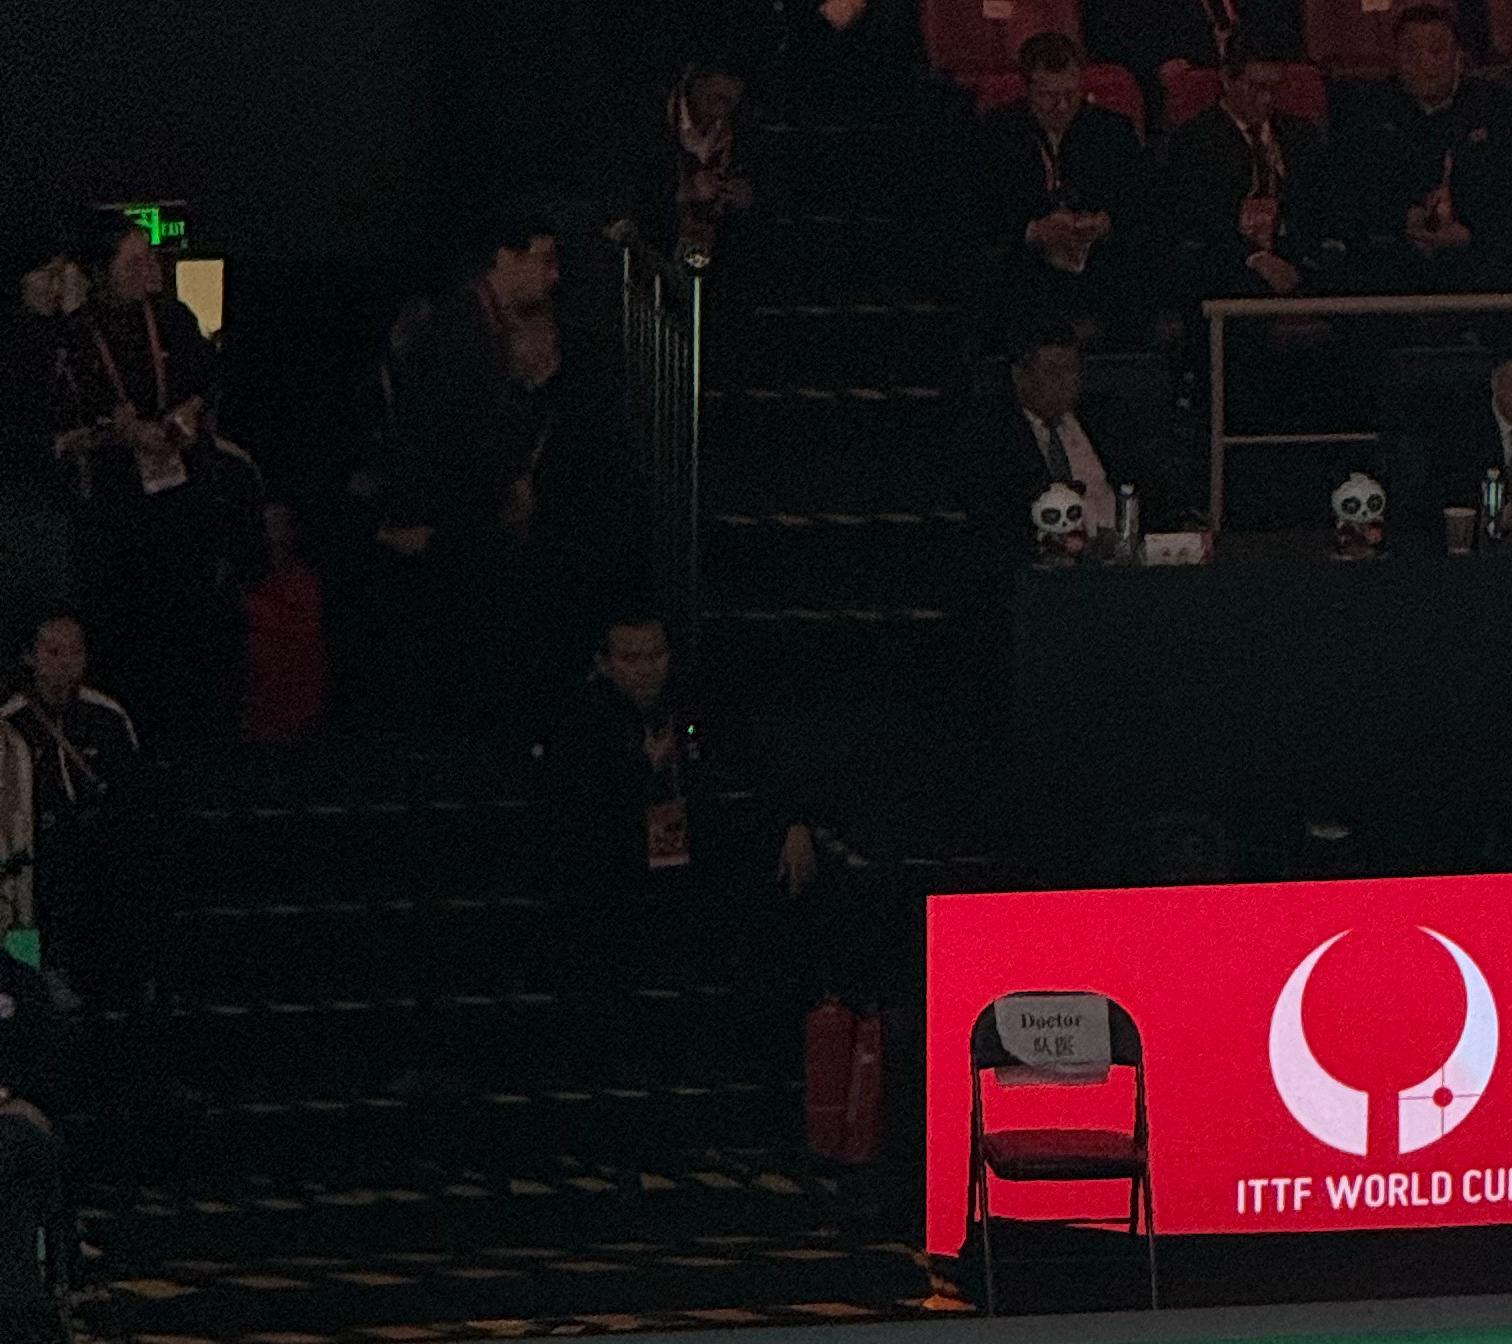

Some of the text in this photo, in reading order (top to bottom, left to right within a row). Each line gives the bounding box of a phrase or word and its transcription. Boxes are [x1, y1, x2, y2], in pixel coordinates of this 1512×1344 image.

[1020, 1012, 1082, 1030] Doctor
[1236, 1176, 1312, 1214] ITTF
[1325, 1171, 1453, 1210] WORLD
